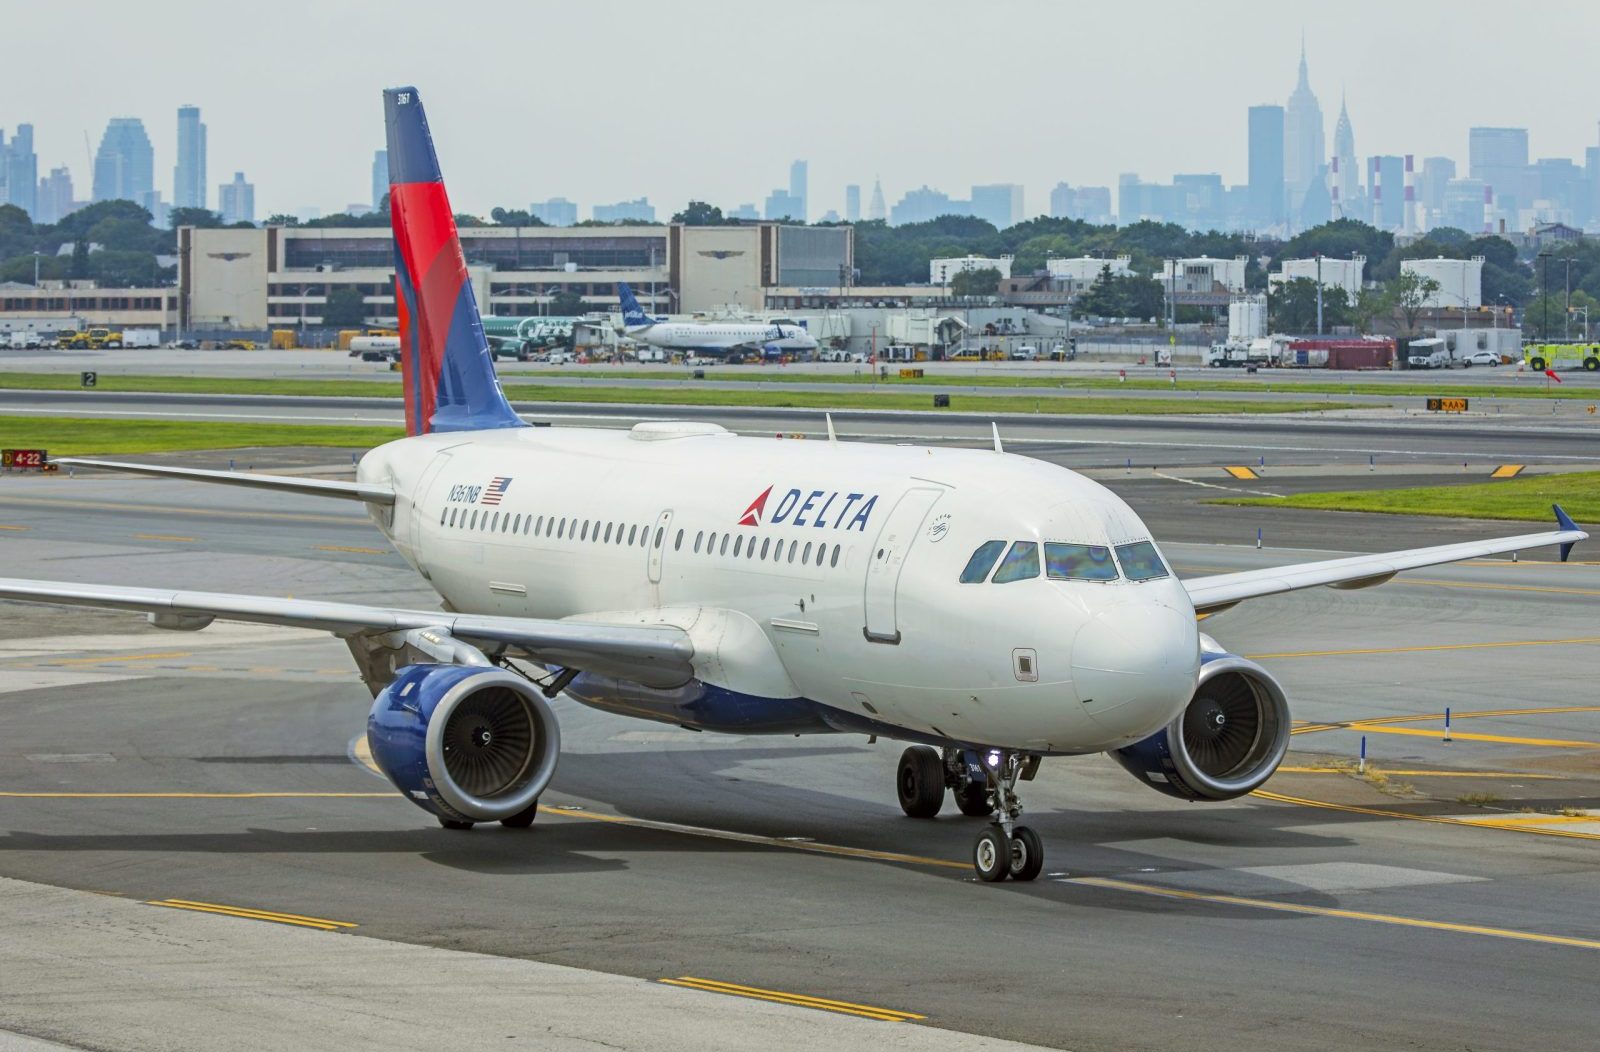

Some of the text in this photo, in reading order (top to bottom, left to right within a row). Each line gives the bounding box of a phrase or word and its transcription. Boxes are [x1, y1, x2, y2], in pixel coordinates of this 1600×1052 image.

[86, 373, 94, 385] 2
[15, 453, 40, 465] 4-22
[770, 488, 880, 532] DELTA
